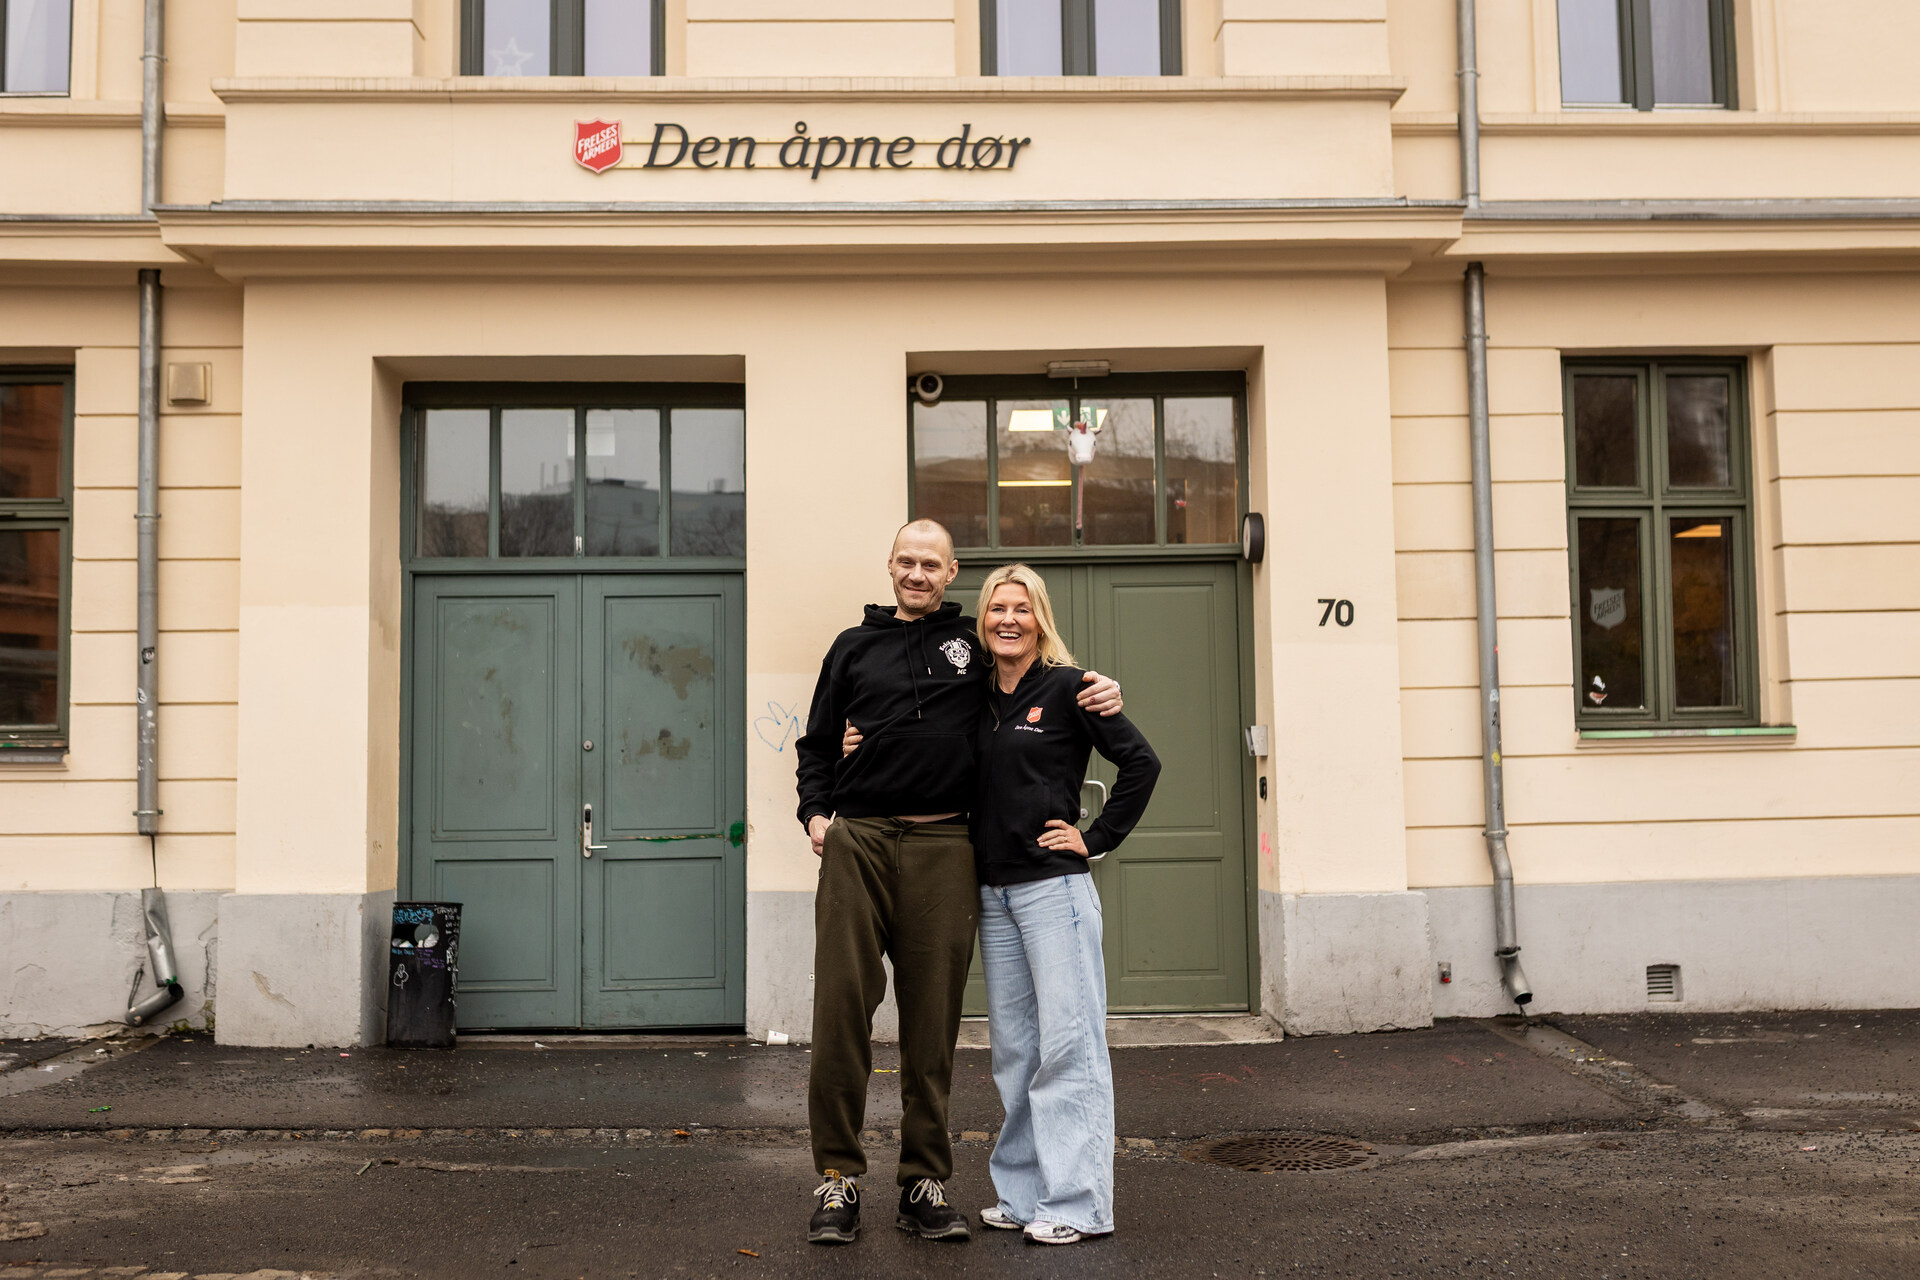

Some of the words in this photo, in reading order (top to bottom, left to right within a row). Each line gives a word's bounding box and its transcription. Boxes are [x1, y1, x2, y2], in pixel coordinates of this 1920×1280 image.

[578, 124, 617, 154] FRELSES
[581, 135, 618, 163] ARMEEN
[642, 123, 756, 169] Den
[778, 121, 915, 180] åpne
[935, 123, 1032, 172] dør
[1317, 598, 1354, 627] 70
